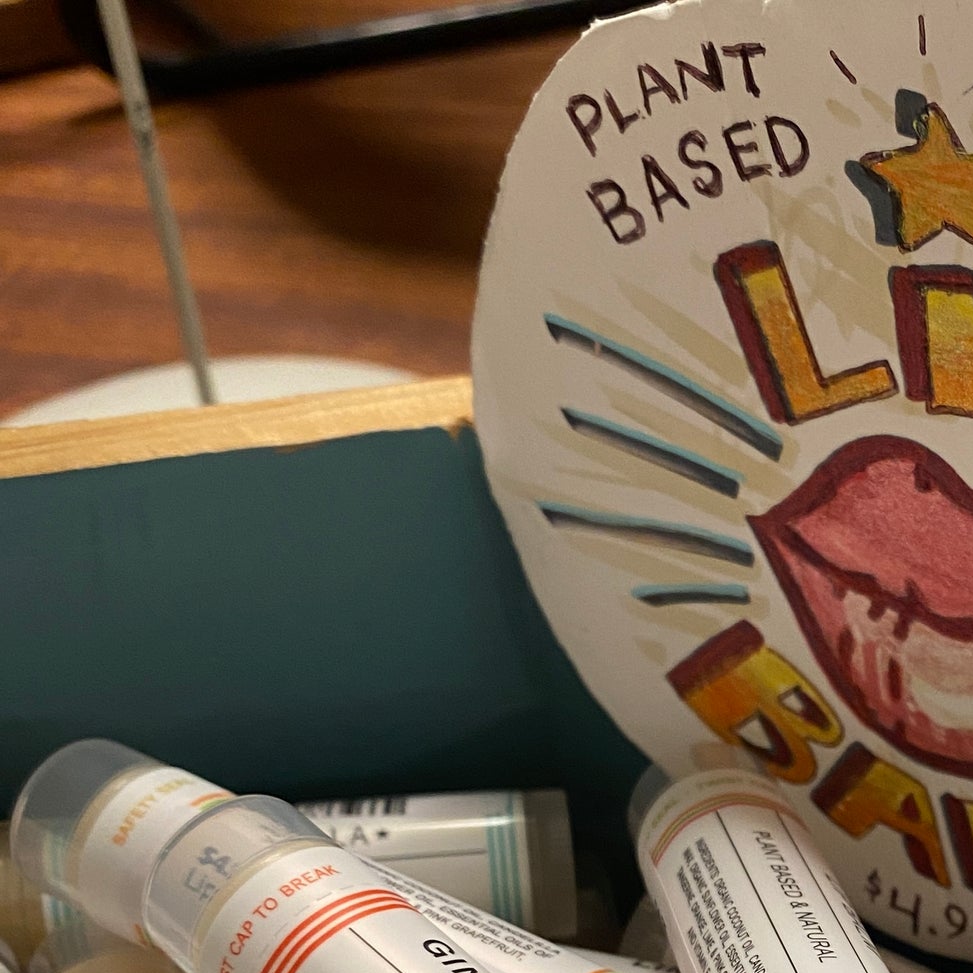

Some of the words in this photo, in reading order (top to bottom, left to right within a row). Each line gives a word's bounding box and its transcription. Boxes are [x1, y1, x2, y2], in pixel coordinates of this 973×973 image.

[565, 41, 767, 157] PLANT
[586, 116, 810, 245] BASED
[753, 829, 785, 866] PLANT
[770, 861, 803, 901] BASED
[229, 920, 254, 956] CAP
[253, 896, 279, 919] TO
[279, 864, 341, 898] BREAK
[790, 900, 809, 910] &
[502, 934, 532, 952] OILS
[534, 947, 556, 959] OF
[795, 909, 838, 963] NATURAL
